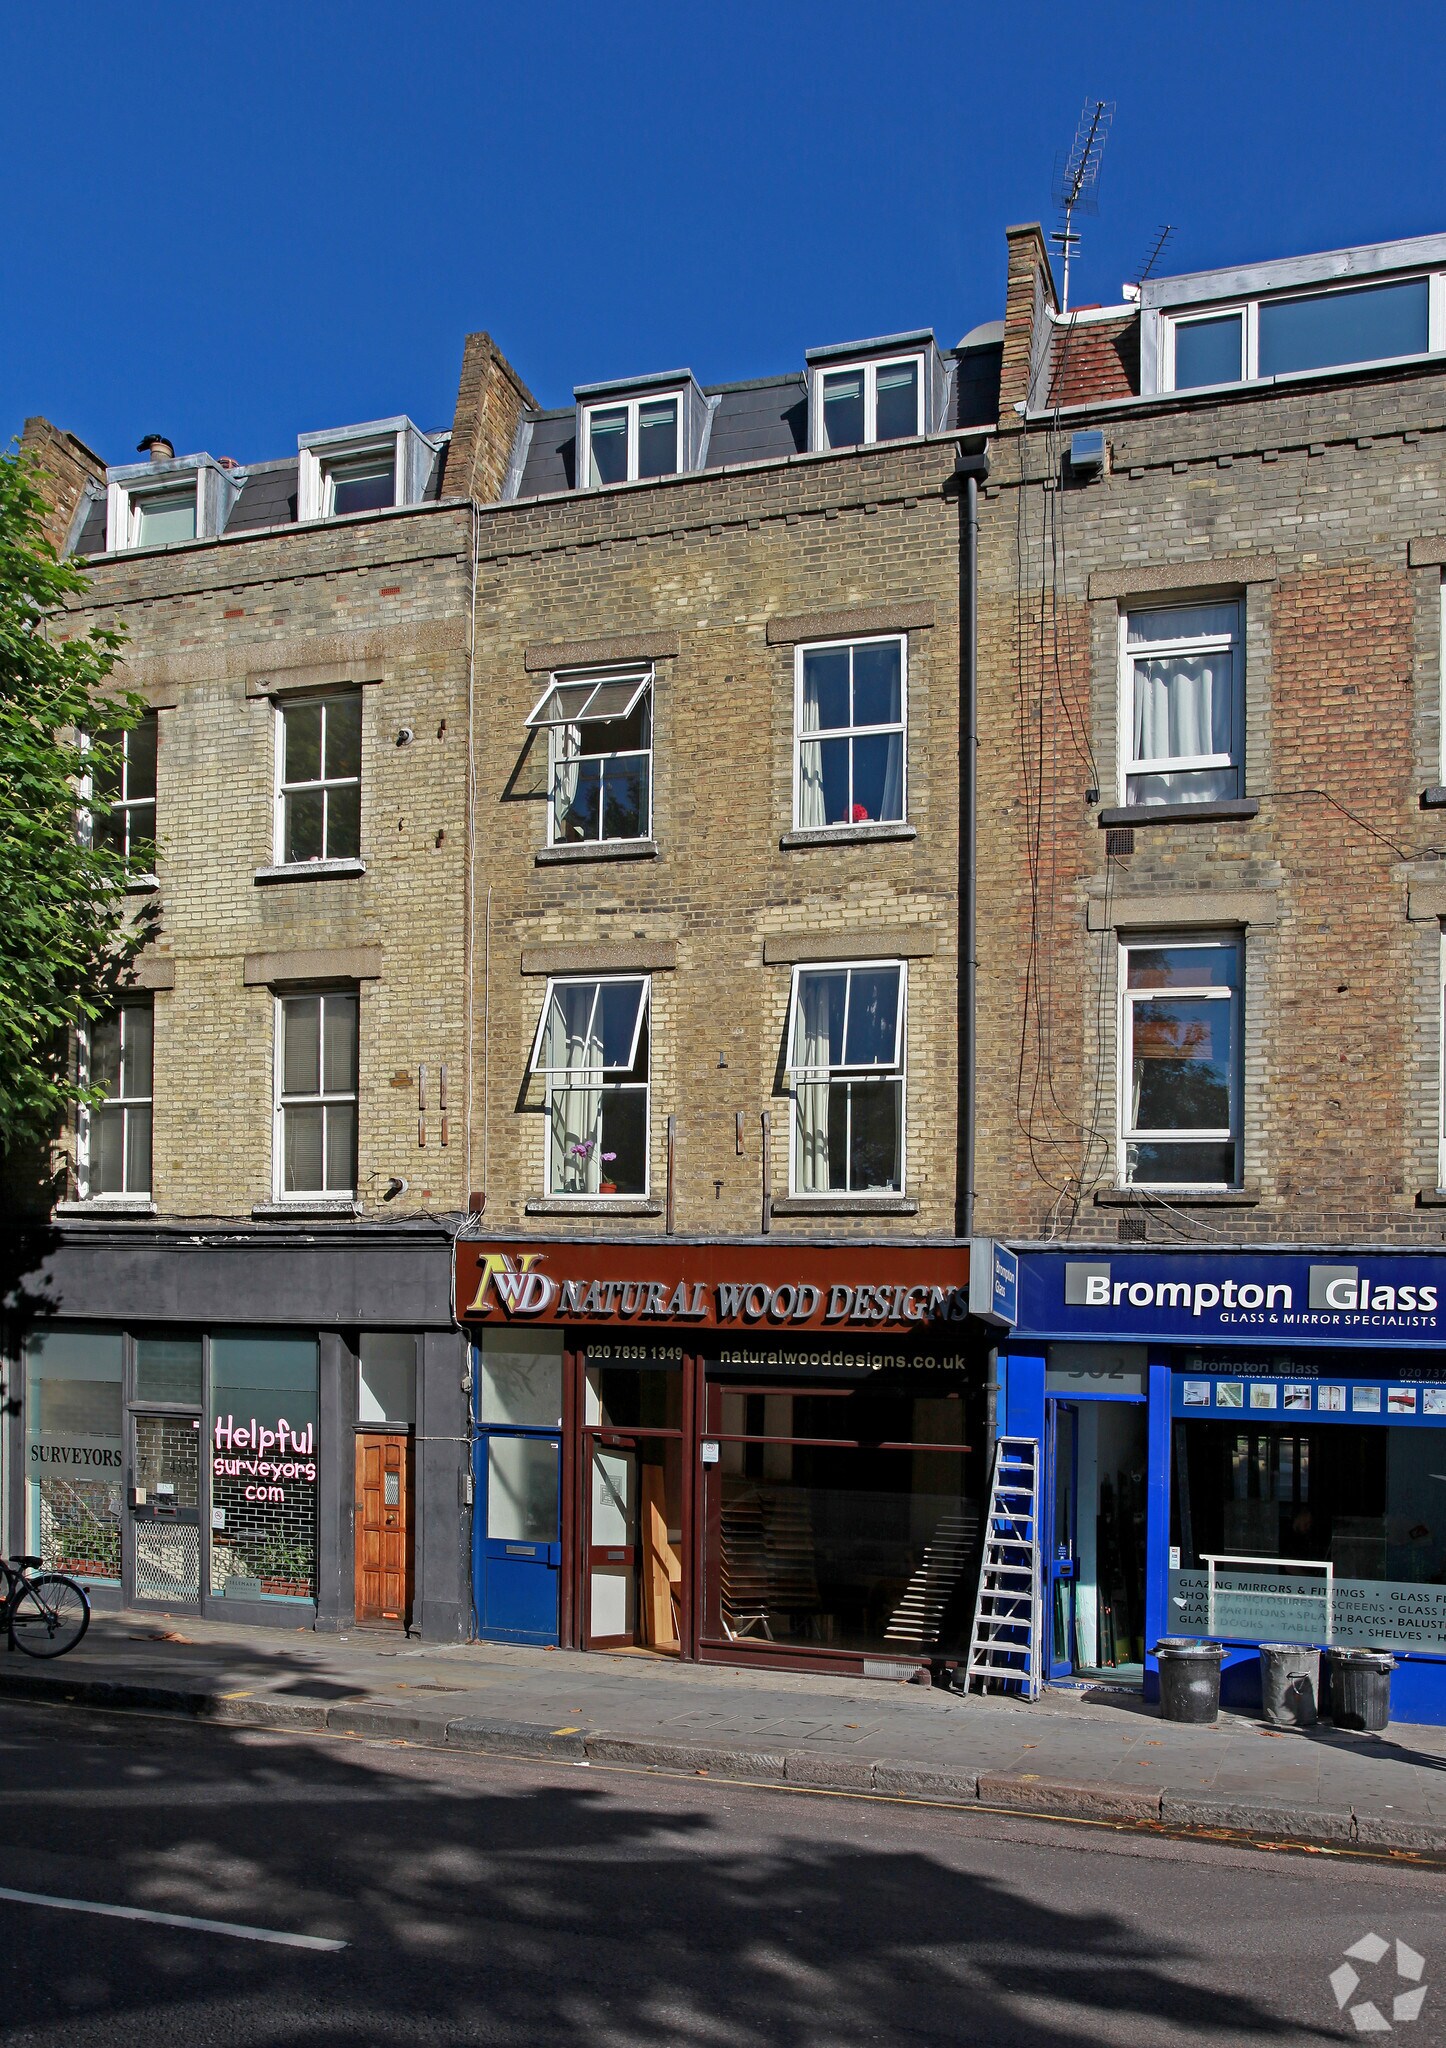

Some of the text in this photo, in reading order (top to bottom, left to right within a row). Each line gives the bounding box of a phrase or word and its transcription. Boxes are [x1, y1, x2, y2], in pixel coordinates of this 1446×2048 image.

[556, 1280, 968, 1321] NATURAL WOOD DESIGNS
[1086, 1276, 1437, 1315] Brompton Glass
[1220, 1312, 1437, 1327] GLASS & MIRROR SPECIALISTS
[587, 1345, 683, 1360] 020 7835 1349
[720, 1349, 967, 1371] naturalwooddesigns.co.uk
[1192, 1359, 1319, 1375] Brompton Glass
[1400, 1368, 1421, 1377] 020
[215, 1414, 313, 1458] Helpful
[31, 1444, 122, 1467] SURVEYORS
[214, 1457, 316, 1481] surveyors
[245, 1485, 285, 1502] com
[1180, 1579, 1233, 1590] GLAZNG
[1238, 1582, 1292, 1594] MIRRORS
[1297, 1586, 1305, 1595] &
[1391, 1592, 1430, 1603] GLASS
[1180, 1603, 1215, 1613] GLAS
[1297, 1610, 1342, 1622] SPLAH
[1347, 1614, 1386, 1625] BACKS
[1331, 1600, 1385, 1613] SCREENS
[1398, 1605, 1437, 1616] GLASS
[1180, 1614, 1215, 1625] GLAS
[1281, 1622, 1318, 1633] TABLE
[1368, 1629, 1422, 1641] SHELVES
